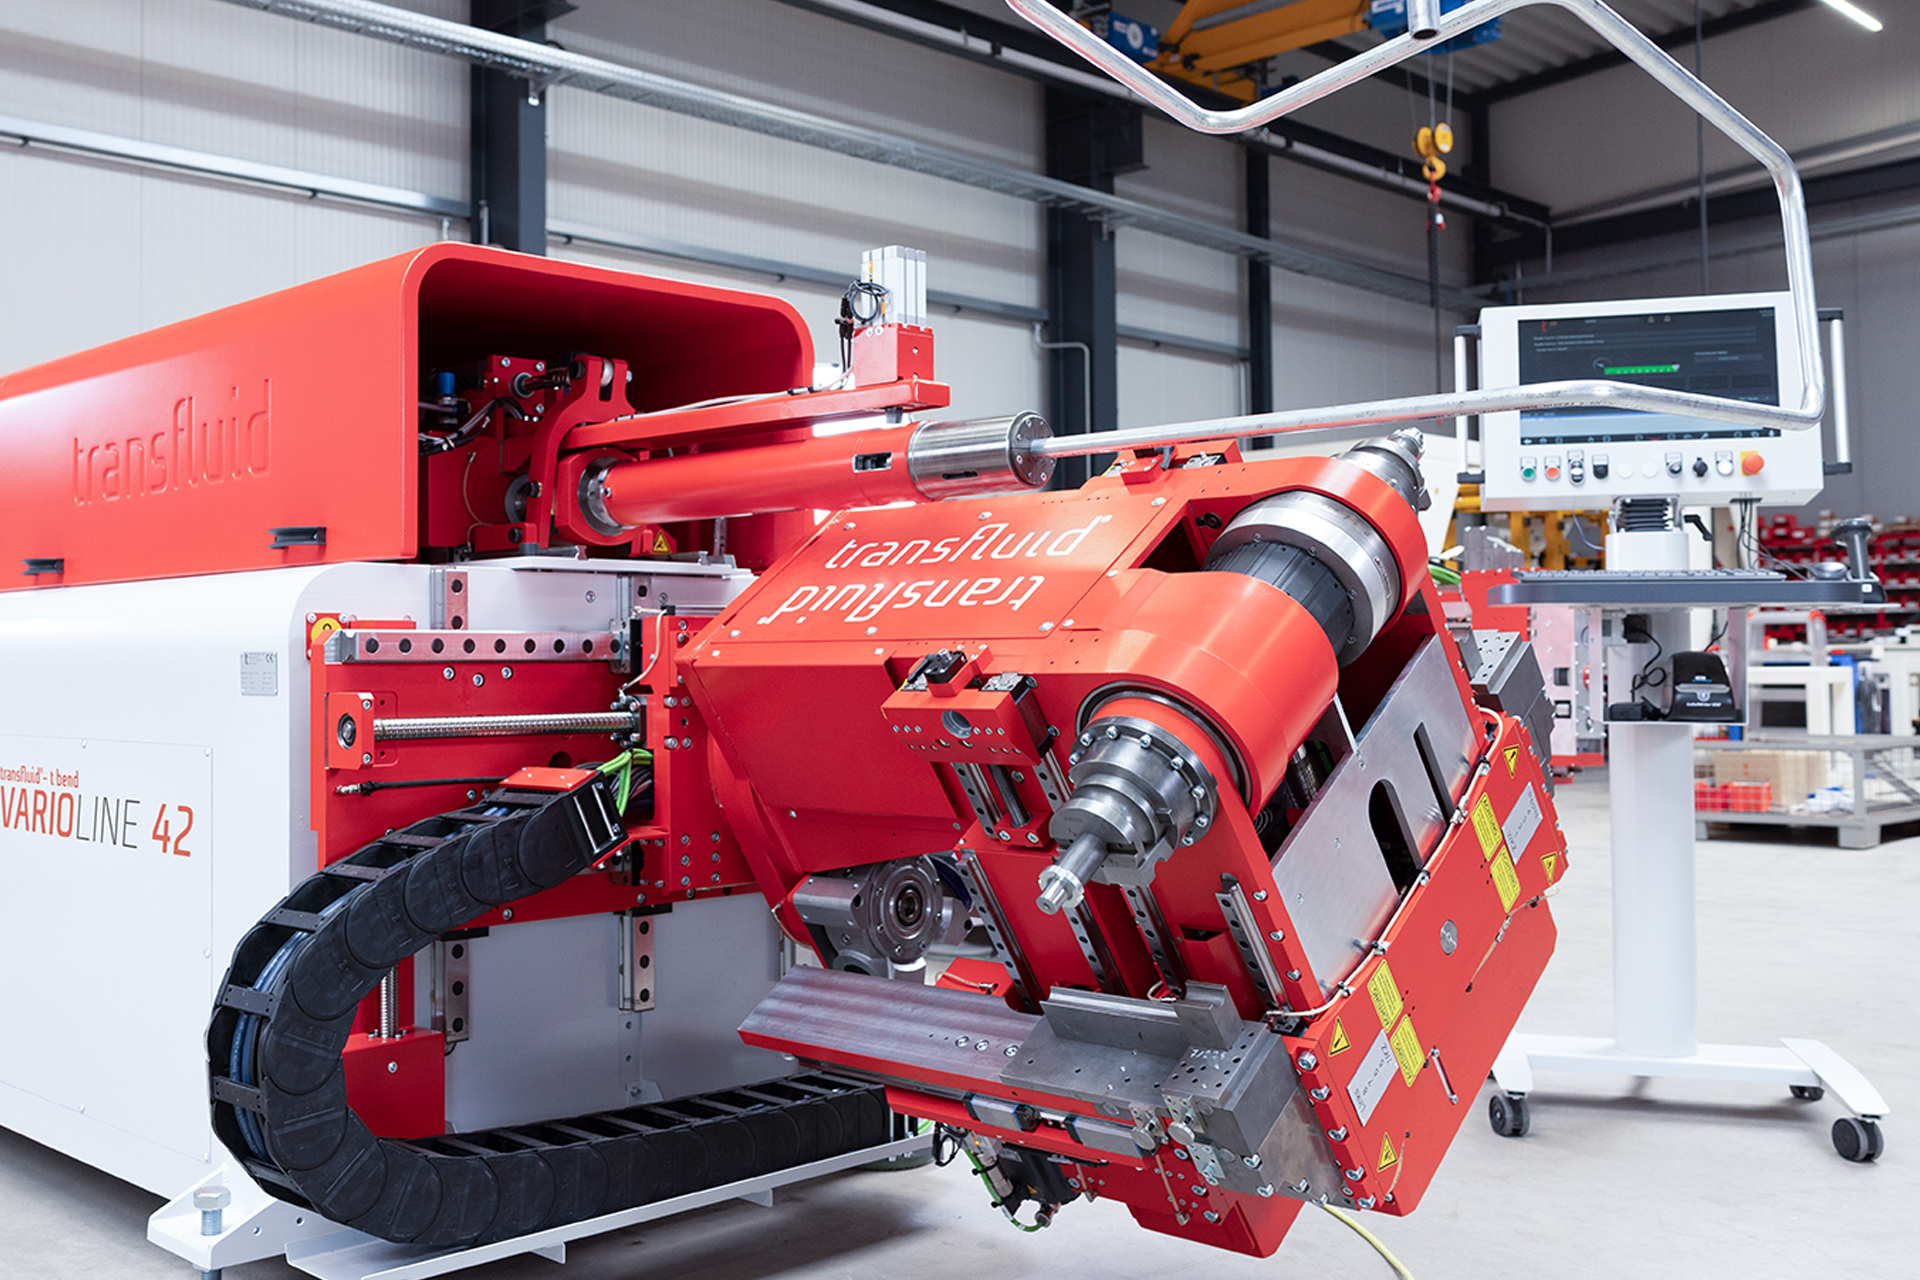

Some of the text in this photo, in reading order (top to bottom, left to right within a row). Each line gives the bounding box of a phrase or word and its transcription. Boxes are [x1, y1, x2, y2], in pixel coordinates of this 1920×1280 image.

[73, 378, 273, 506] transfluid
[56, 768, 79, 788] bend
[151, 803, 194, 857] 42
